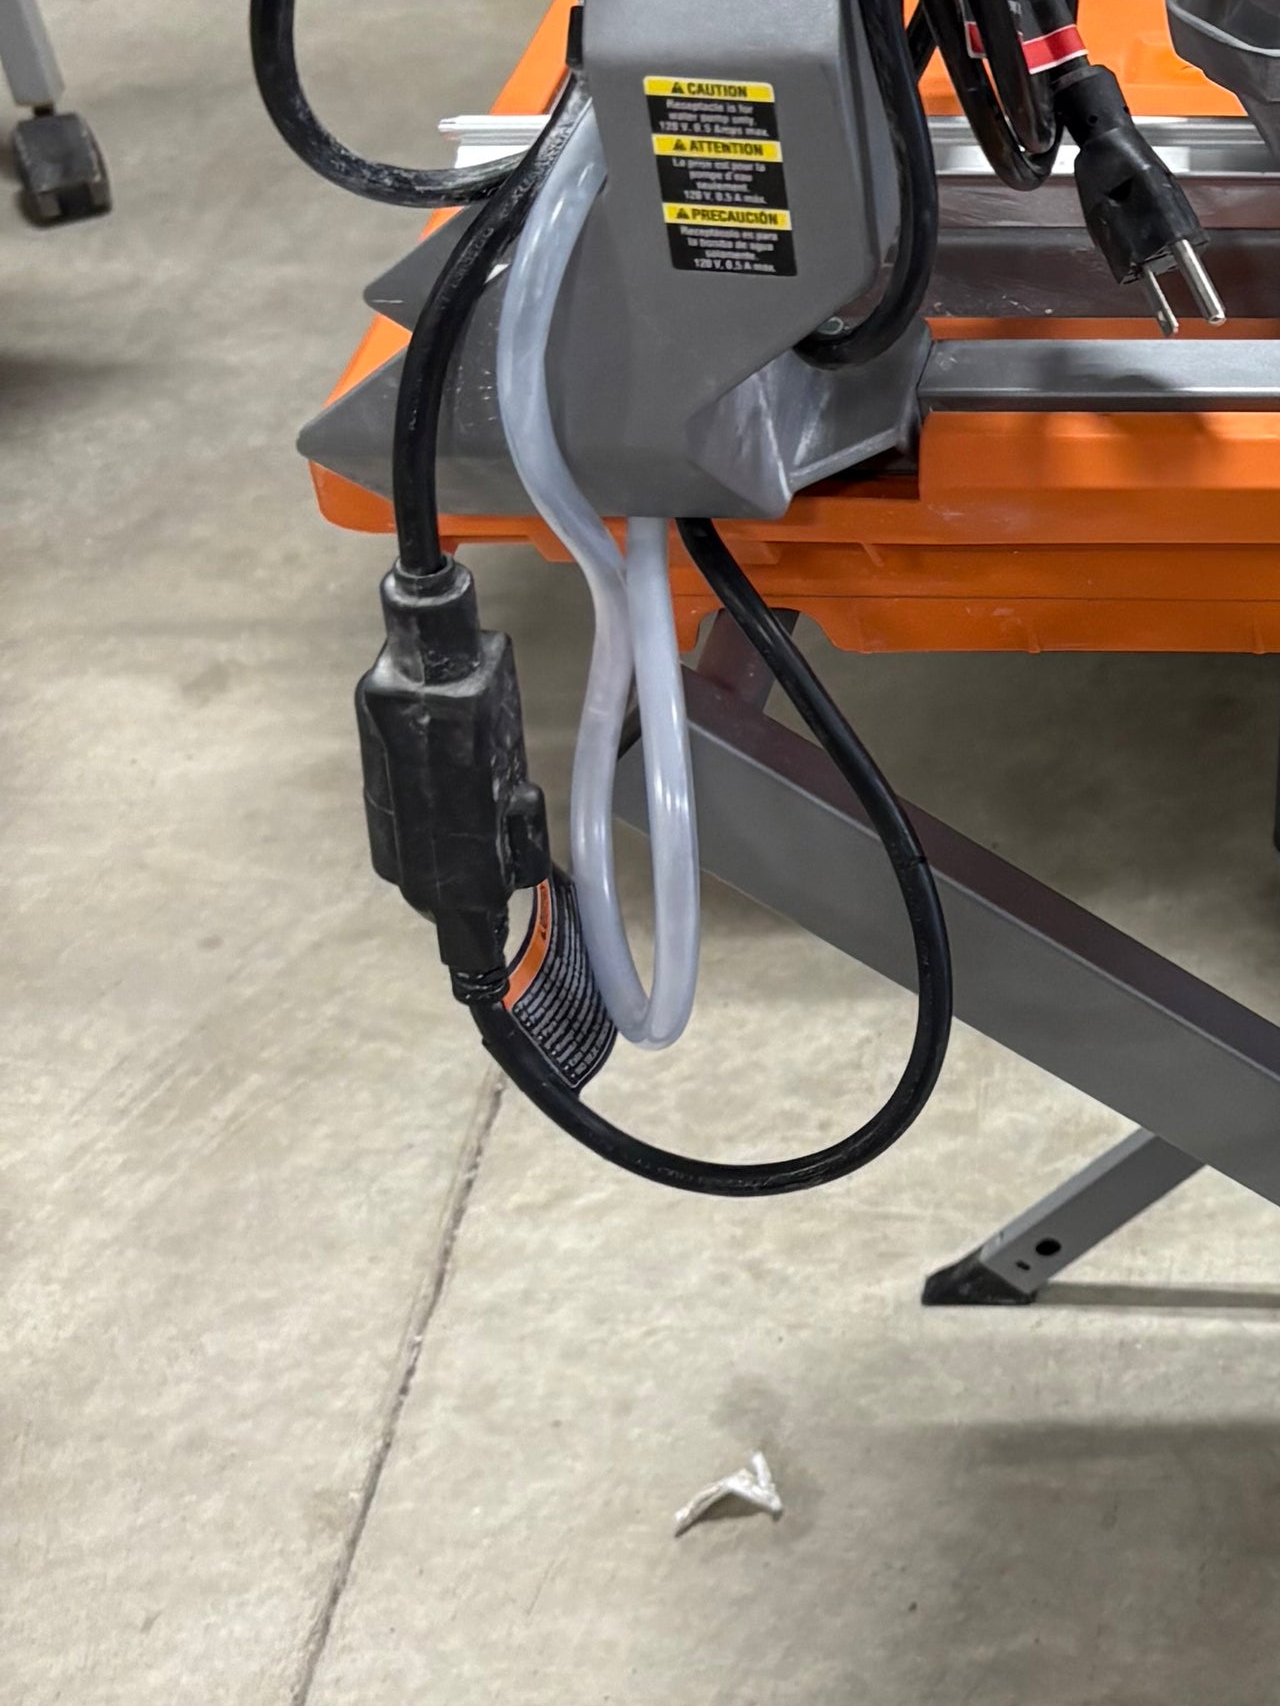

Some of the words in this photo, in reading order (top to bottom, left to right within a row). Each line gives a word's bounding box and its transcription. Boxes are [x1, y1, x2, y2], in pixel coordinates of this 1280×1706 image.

[687, 82, 748, 97] CAUTION
[690, 140, 764, 156] ATTENTION
[691, 207, 779, 225] PRECAUCIÓN
[693, 258, 713, 269] 120
